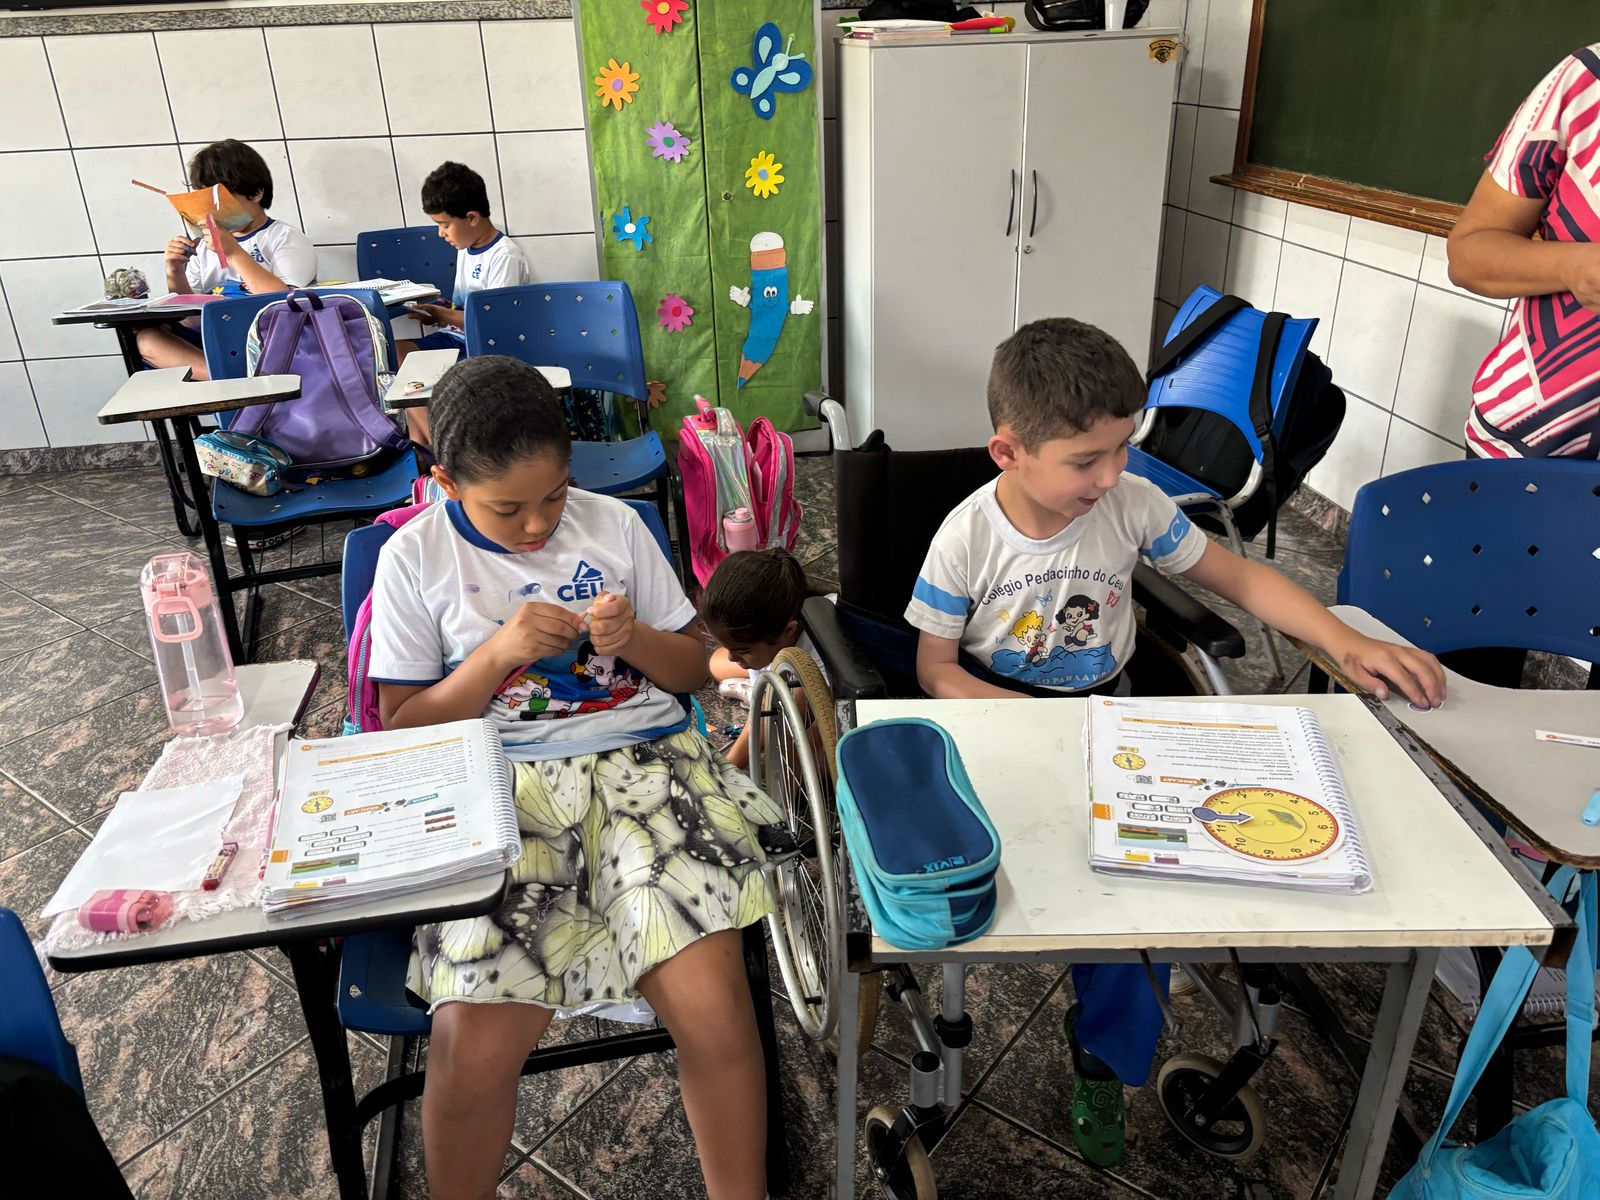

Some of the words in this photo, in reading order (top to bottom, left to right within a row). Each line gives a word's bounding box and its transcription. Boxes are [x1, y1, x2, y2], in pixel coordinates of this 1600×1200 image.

[1025, 565, 1090, 587] Pedacinho
[1093, 568, 1106, 582] do
[1236, 791, 1248, 799] 2
